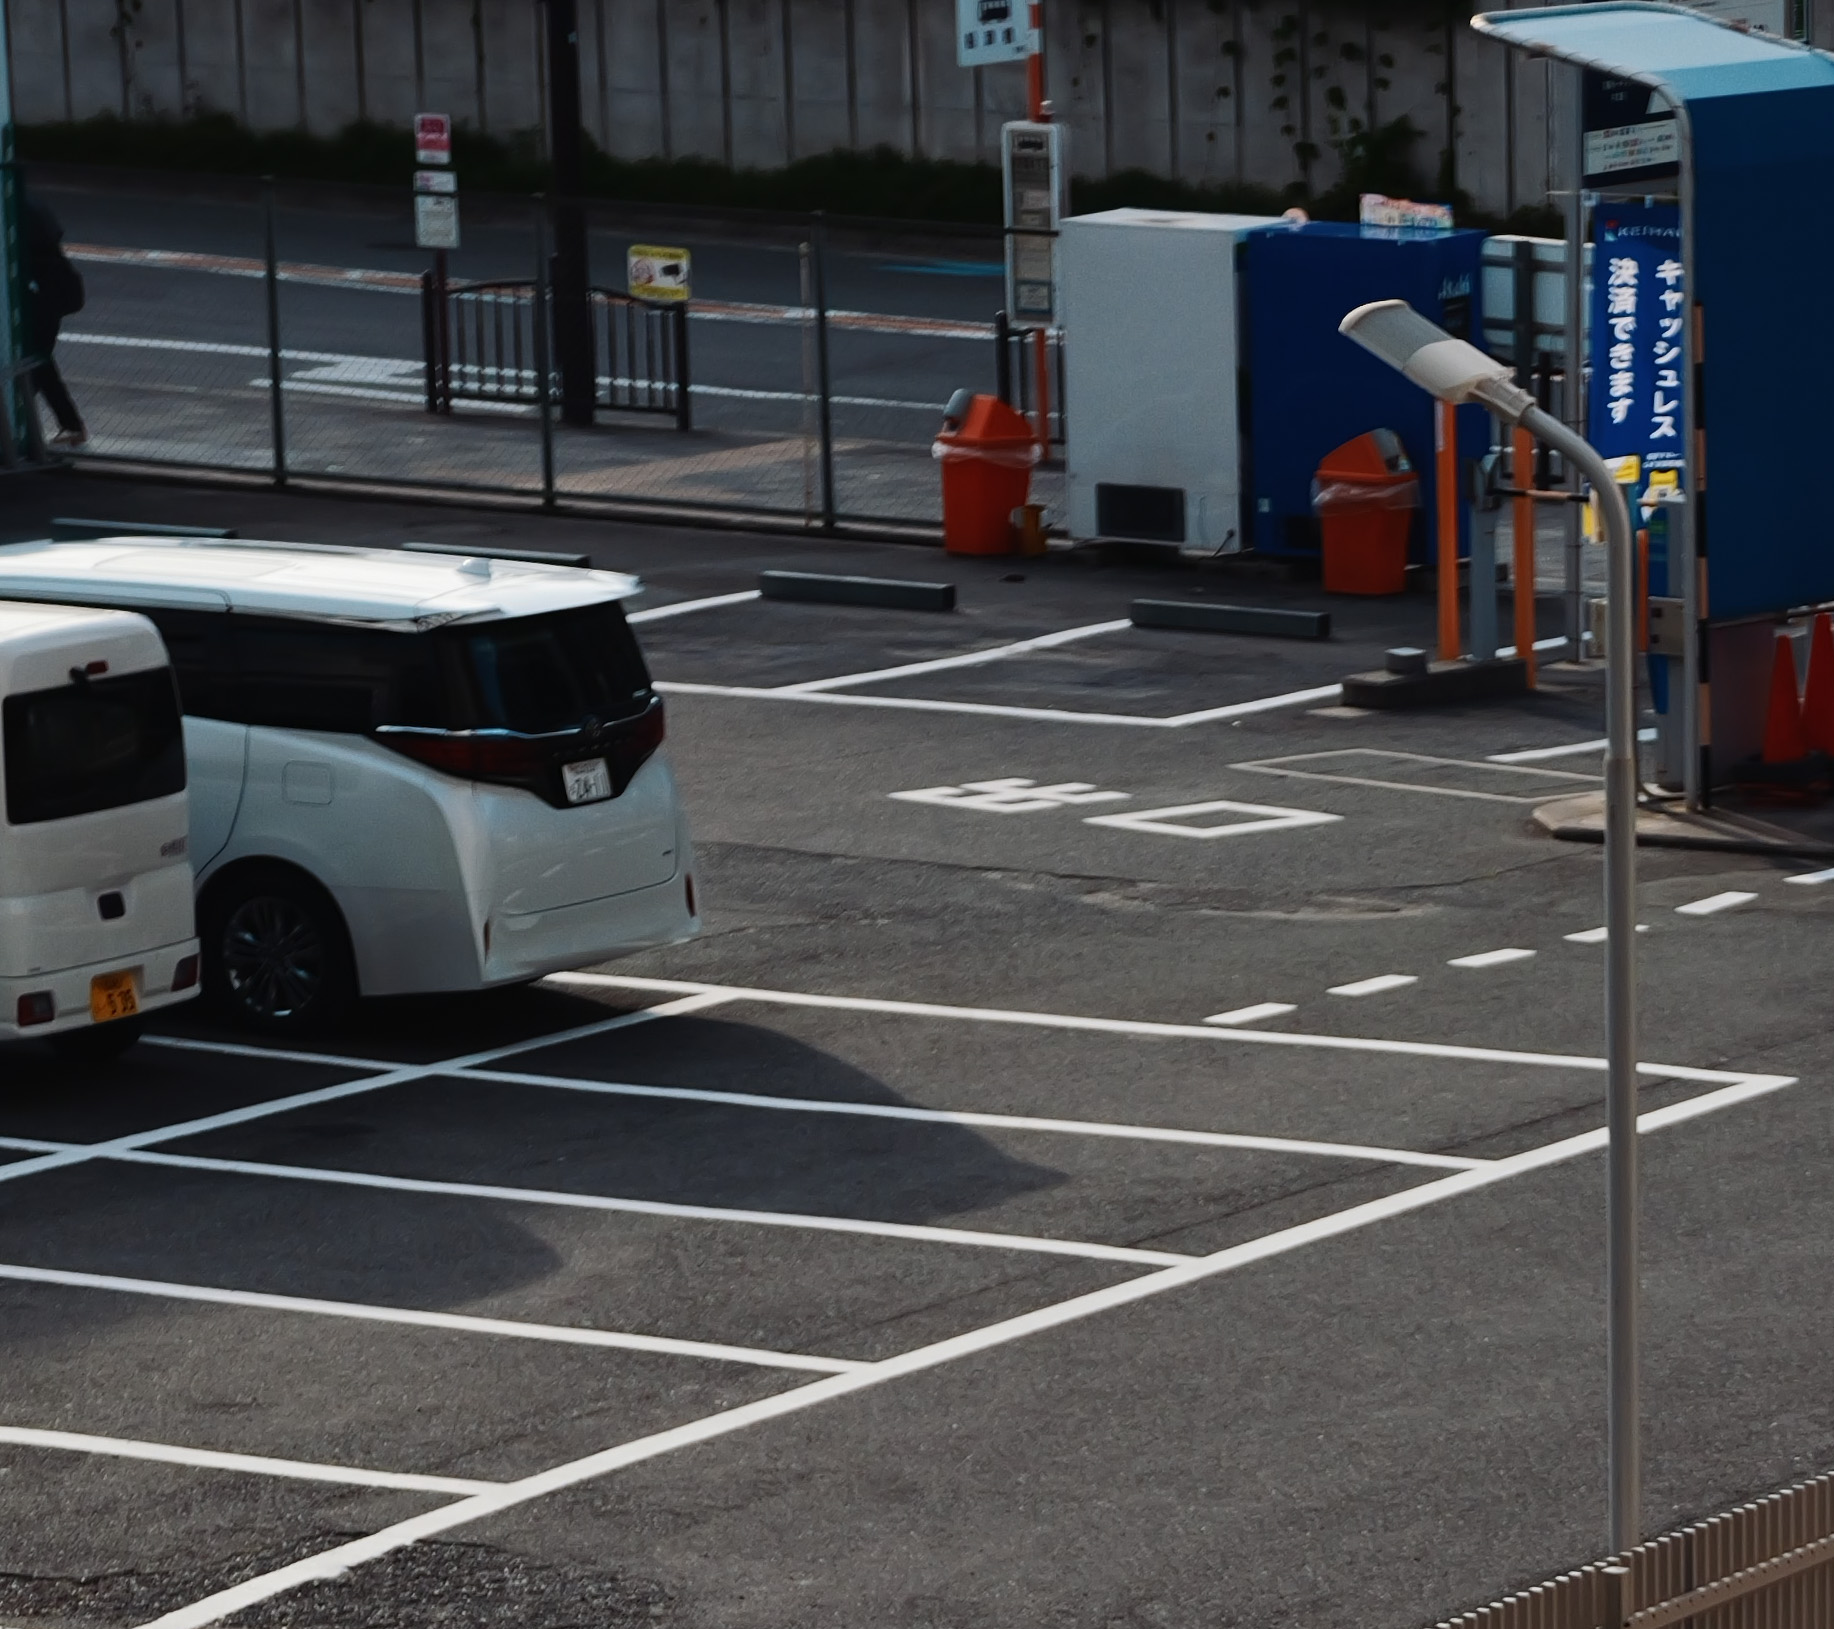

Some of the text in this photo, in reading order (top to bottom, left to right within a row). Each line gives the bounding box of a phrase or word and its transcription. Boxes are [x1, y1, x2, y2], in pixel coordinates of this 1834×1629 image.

[1607, 257, 1639, 424] 決済できます
[1650, 258, 1684, 439] キャッシュレス
